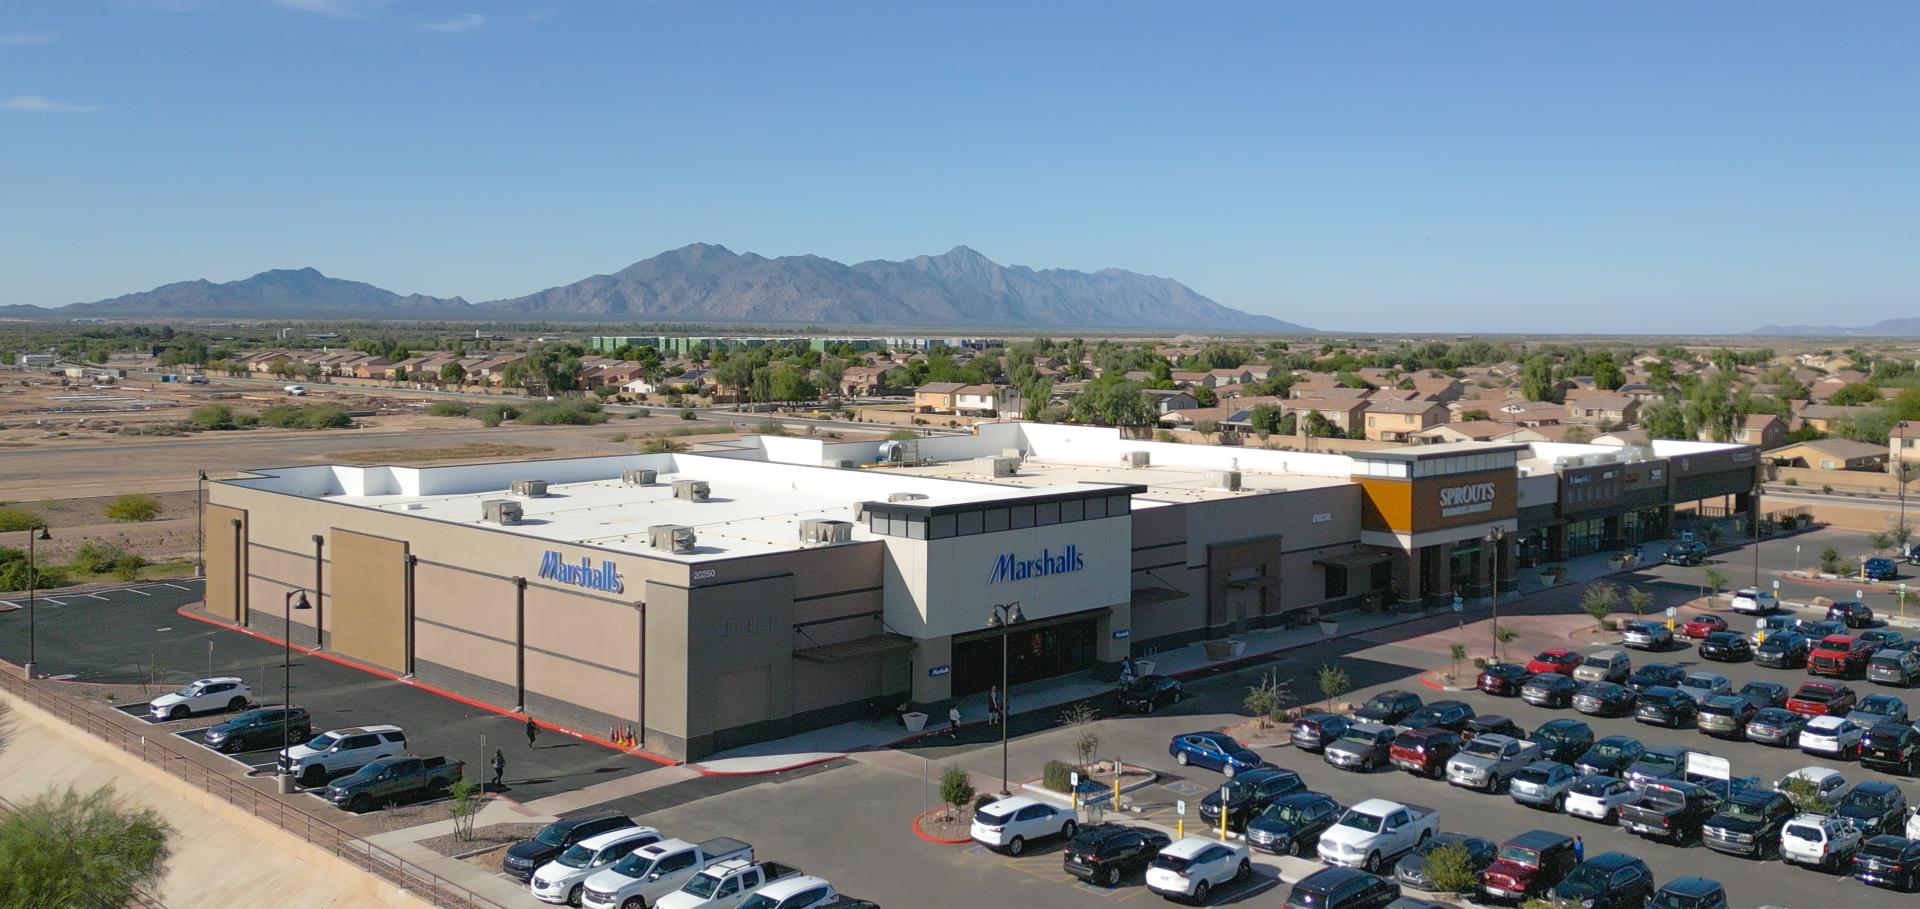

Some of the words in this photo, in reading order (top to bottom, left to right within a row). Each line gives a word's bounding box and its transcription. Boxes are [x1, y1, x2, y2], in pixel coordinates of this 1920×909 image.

[1440, 482, 1495, 506] SPROUTS
[538, 550, 624, 594] Marshalls
[987, 544, 1084, 585] Marshalls
